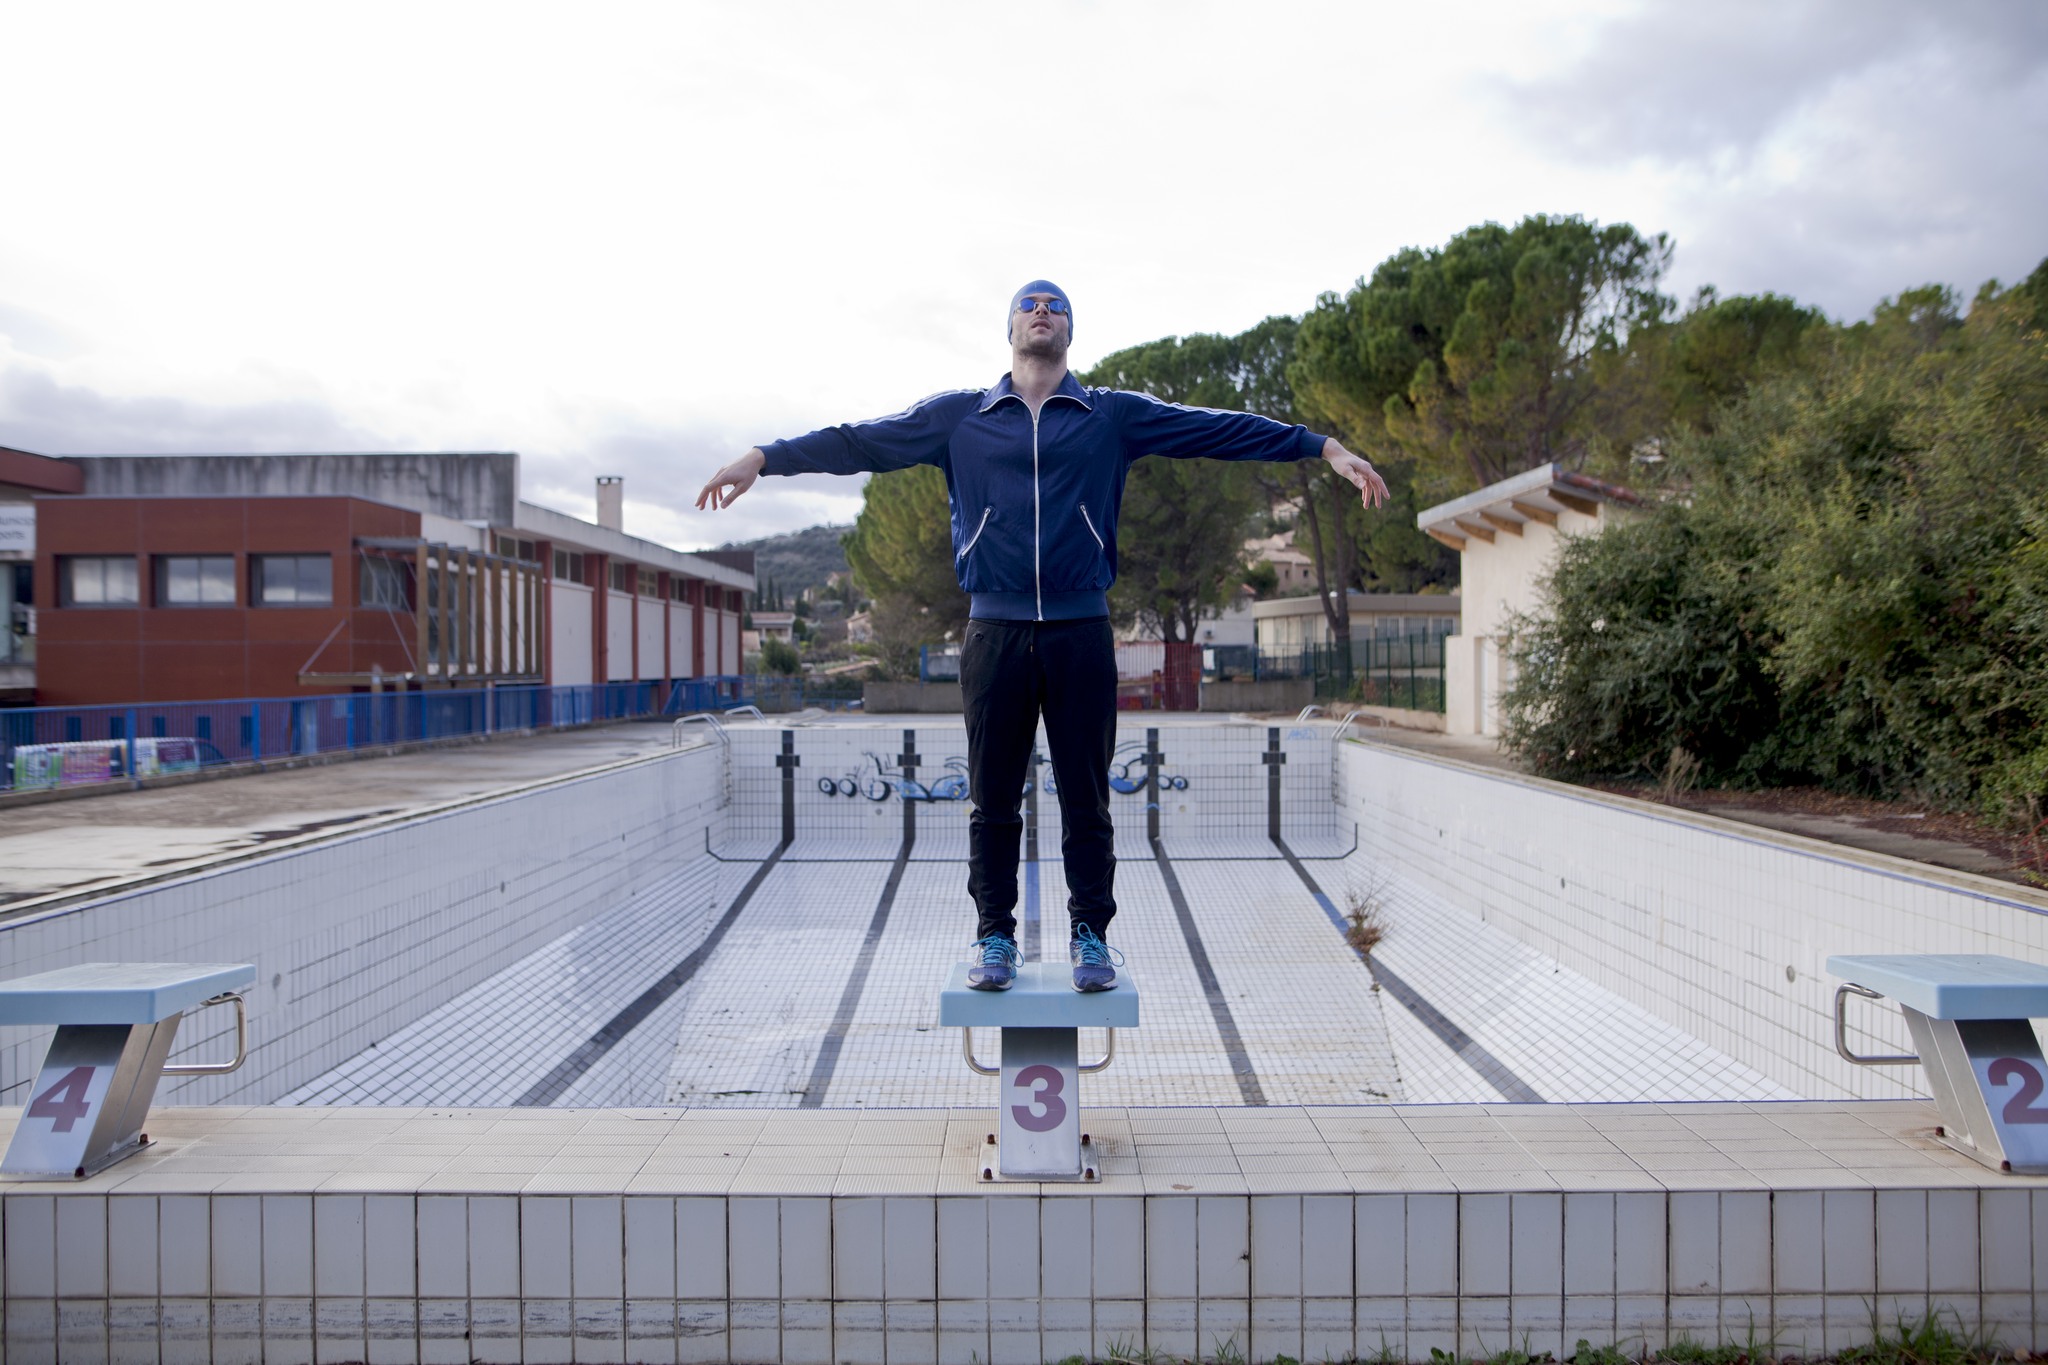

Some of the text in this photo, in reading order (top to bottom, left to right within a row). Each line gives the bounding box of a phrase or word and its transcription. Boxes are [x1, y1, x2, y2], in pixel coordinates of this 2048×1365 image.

[27, 1066, 96, 1132] 4
[1011, 1064, 1067, 1132] 3
[1988, 1057, 2048, 1124] 2
